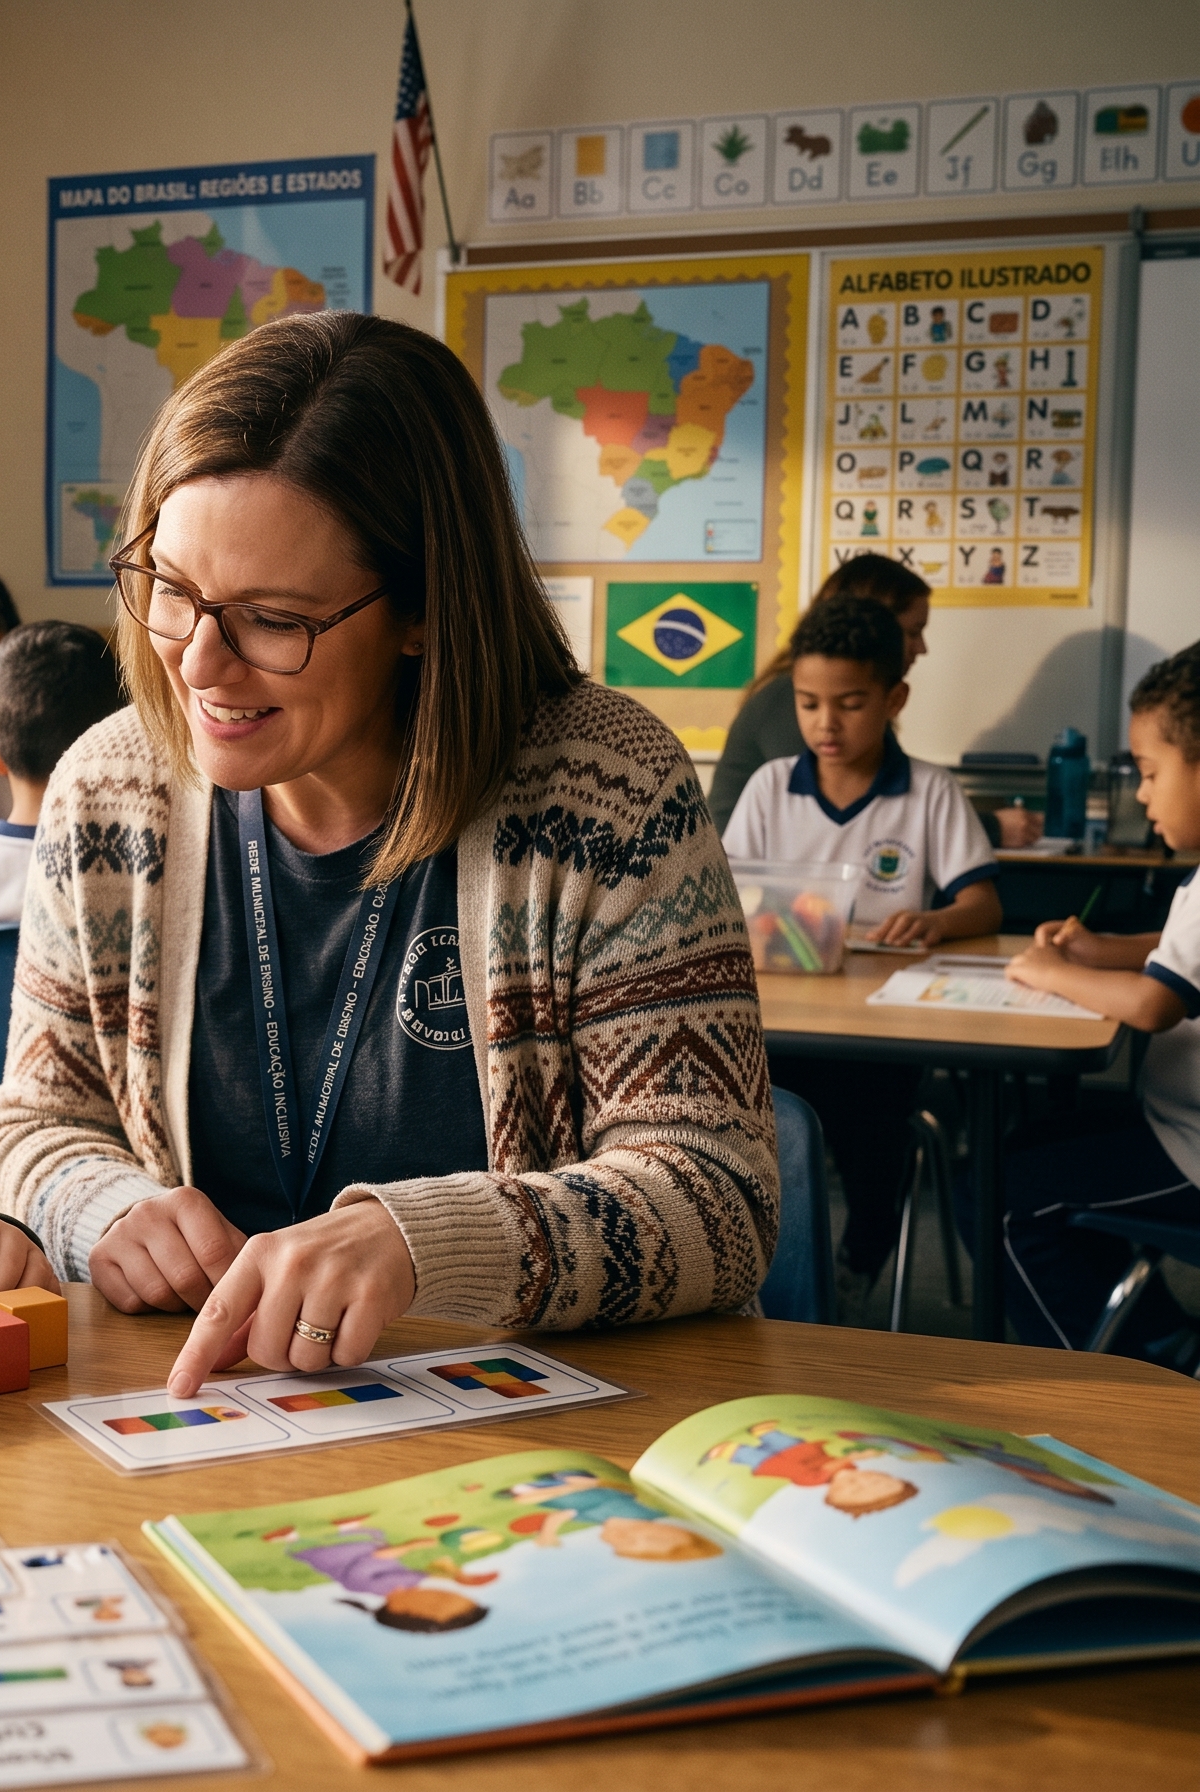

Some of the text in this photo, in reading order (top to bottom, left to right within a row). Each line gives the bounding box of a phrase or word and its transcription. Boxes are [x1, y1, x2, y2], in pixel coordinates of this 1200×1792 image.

[788, 164, 823, 192] Dd
[866, 162, 898, 187] Ee
[1017, 151, 1057, 184] Gg
[60, 188, 103, 208] MAPA
[107, 186, 131, 205] DO
[134, 182, 196, 203] BRASIL:
[271, 174, 283, 194] E
[286, 169, 362, 192] ESTADOS
[504, 186, 536, 210] Aa
[573, 180, 603, 206] Bb
[642, 175, 676, 200] Cc
[839, 262, 1092, 294] ALFABETO ILUSTRADO
[841, 308, 859, 330] A
[904, 305, 920, 326] B
[967, 302, 985, 323] C
[1031, 300, 1051, 321] D
[840, 356, 853, 377] E
[903, 354, 916, 375] F
[965, 351, 986, 373] G
[1029, 349, 1050, 371] H
[838, 403, 850, 425] J
[901, 402, 914, 423] L
[963, 400, 988, 422] M
[1028, 398, 1048, 420] N
[836, 452, 856, 474] O
[899, 451, 915, 472] P
[962, 450, 983, 471] Q
[1026, 449, 1042, 470] R
[835, 500, 854, 521] Q
[898, 499, 913, 519] R
[961, 498, 976, 519] S
[1024, 497, 1040, 518] T
[834, 548, 850, 567] V
[899, 547, 915, 567] X
[958, 546, 975, 567] Y
[1022, 545, 1039, 567] Z
[258, 945, 270, 962] DE
[274, 1092, 291, 1158] INCLUSIVA
[331, 1040, 345, 1058] DE
